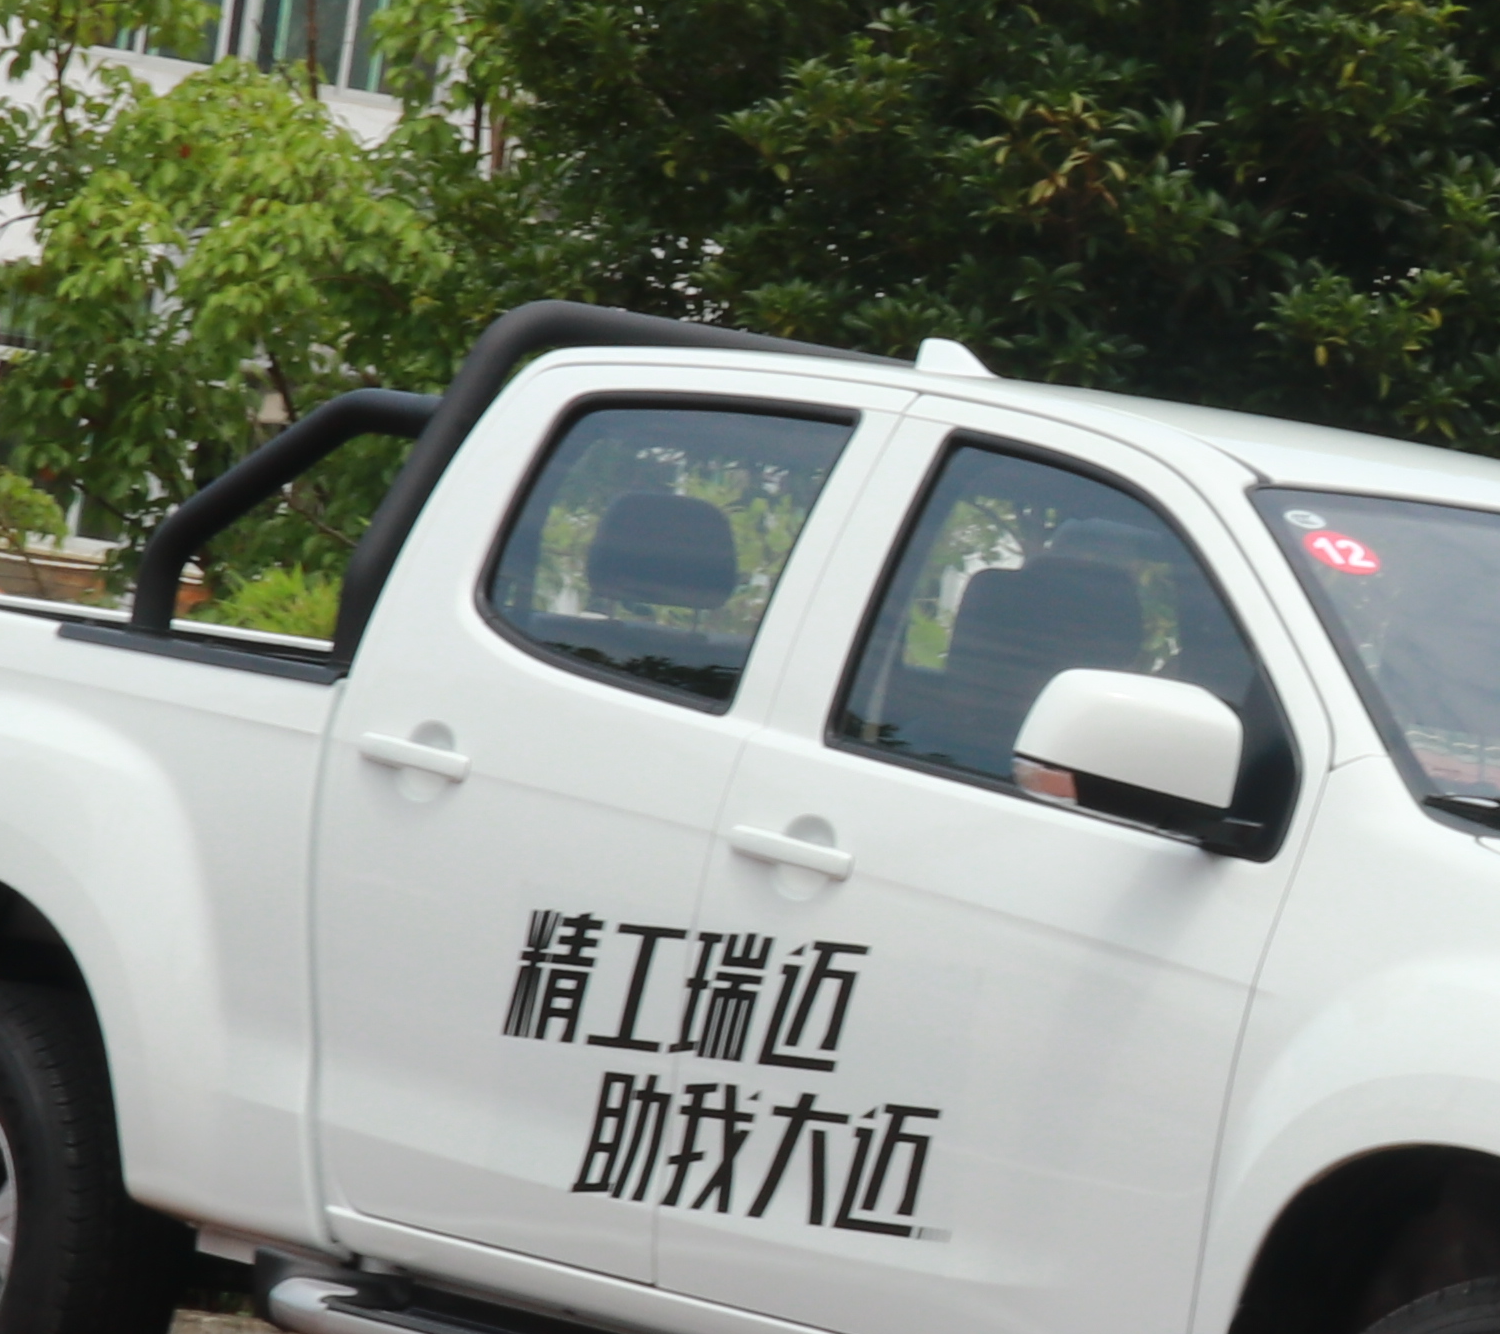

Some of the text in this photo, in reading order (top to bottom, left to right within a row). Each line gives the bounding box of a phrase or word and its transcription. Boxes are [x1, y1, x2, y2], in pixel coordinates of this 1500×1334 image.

[1312, 536, 1377, 568] 12
[503, 909, 871, 1072] 精工瑞迈
[571, 1071, 944, 1240] 助我大迈
